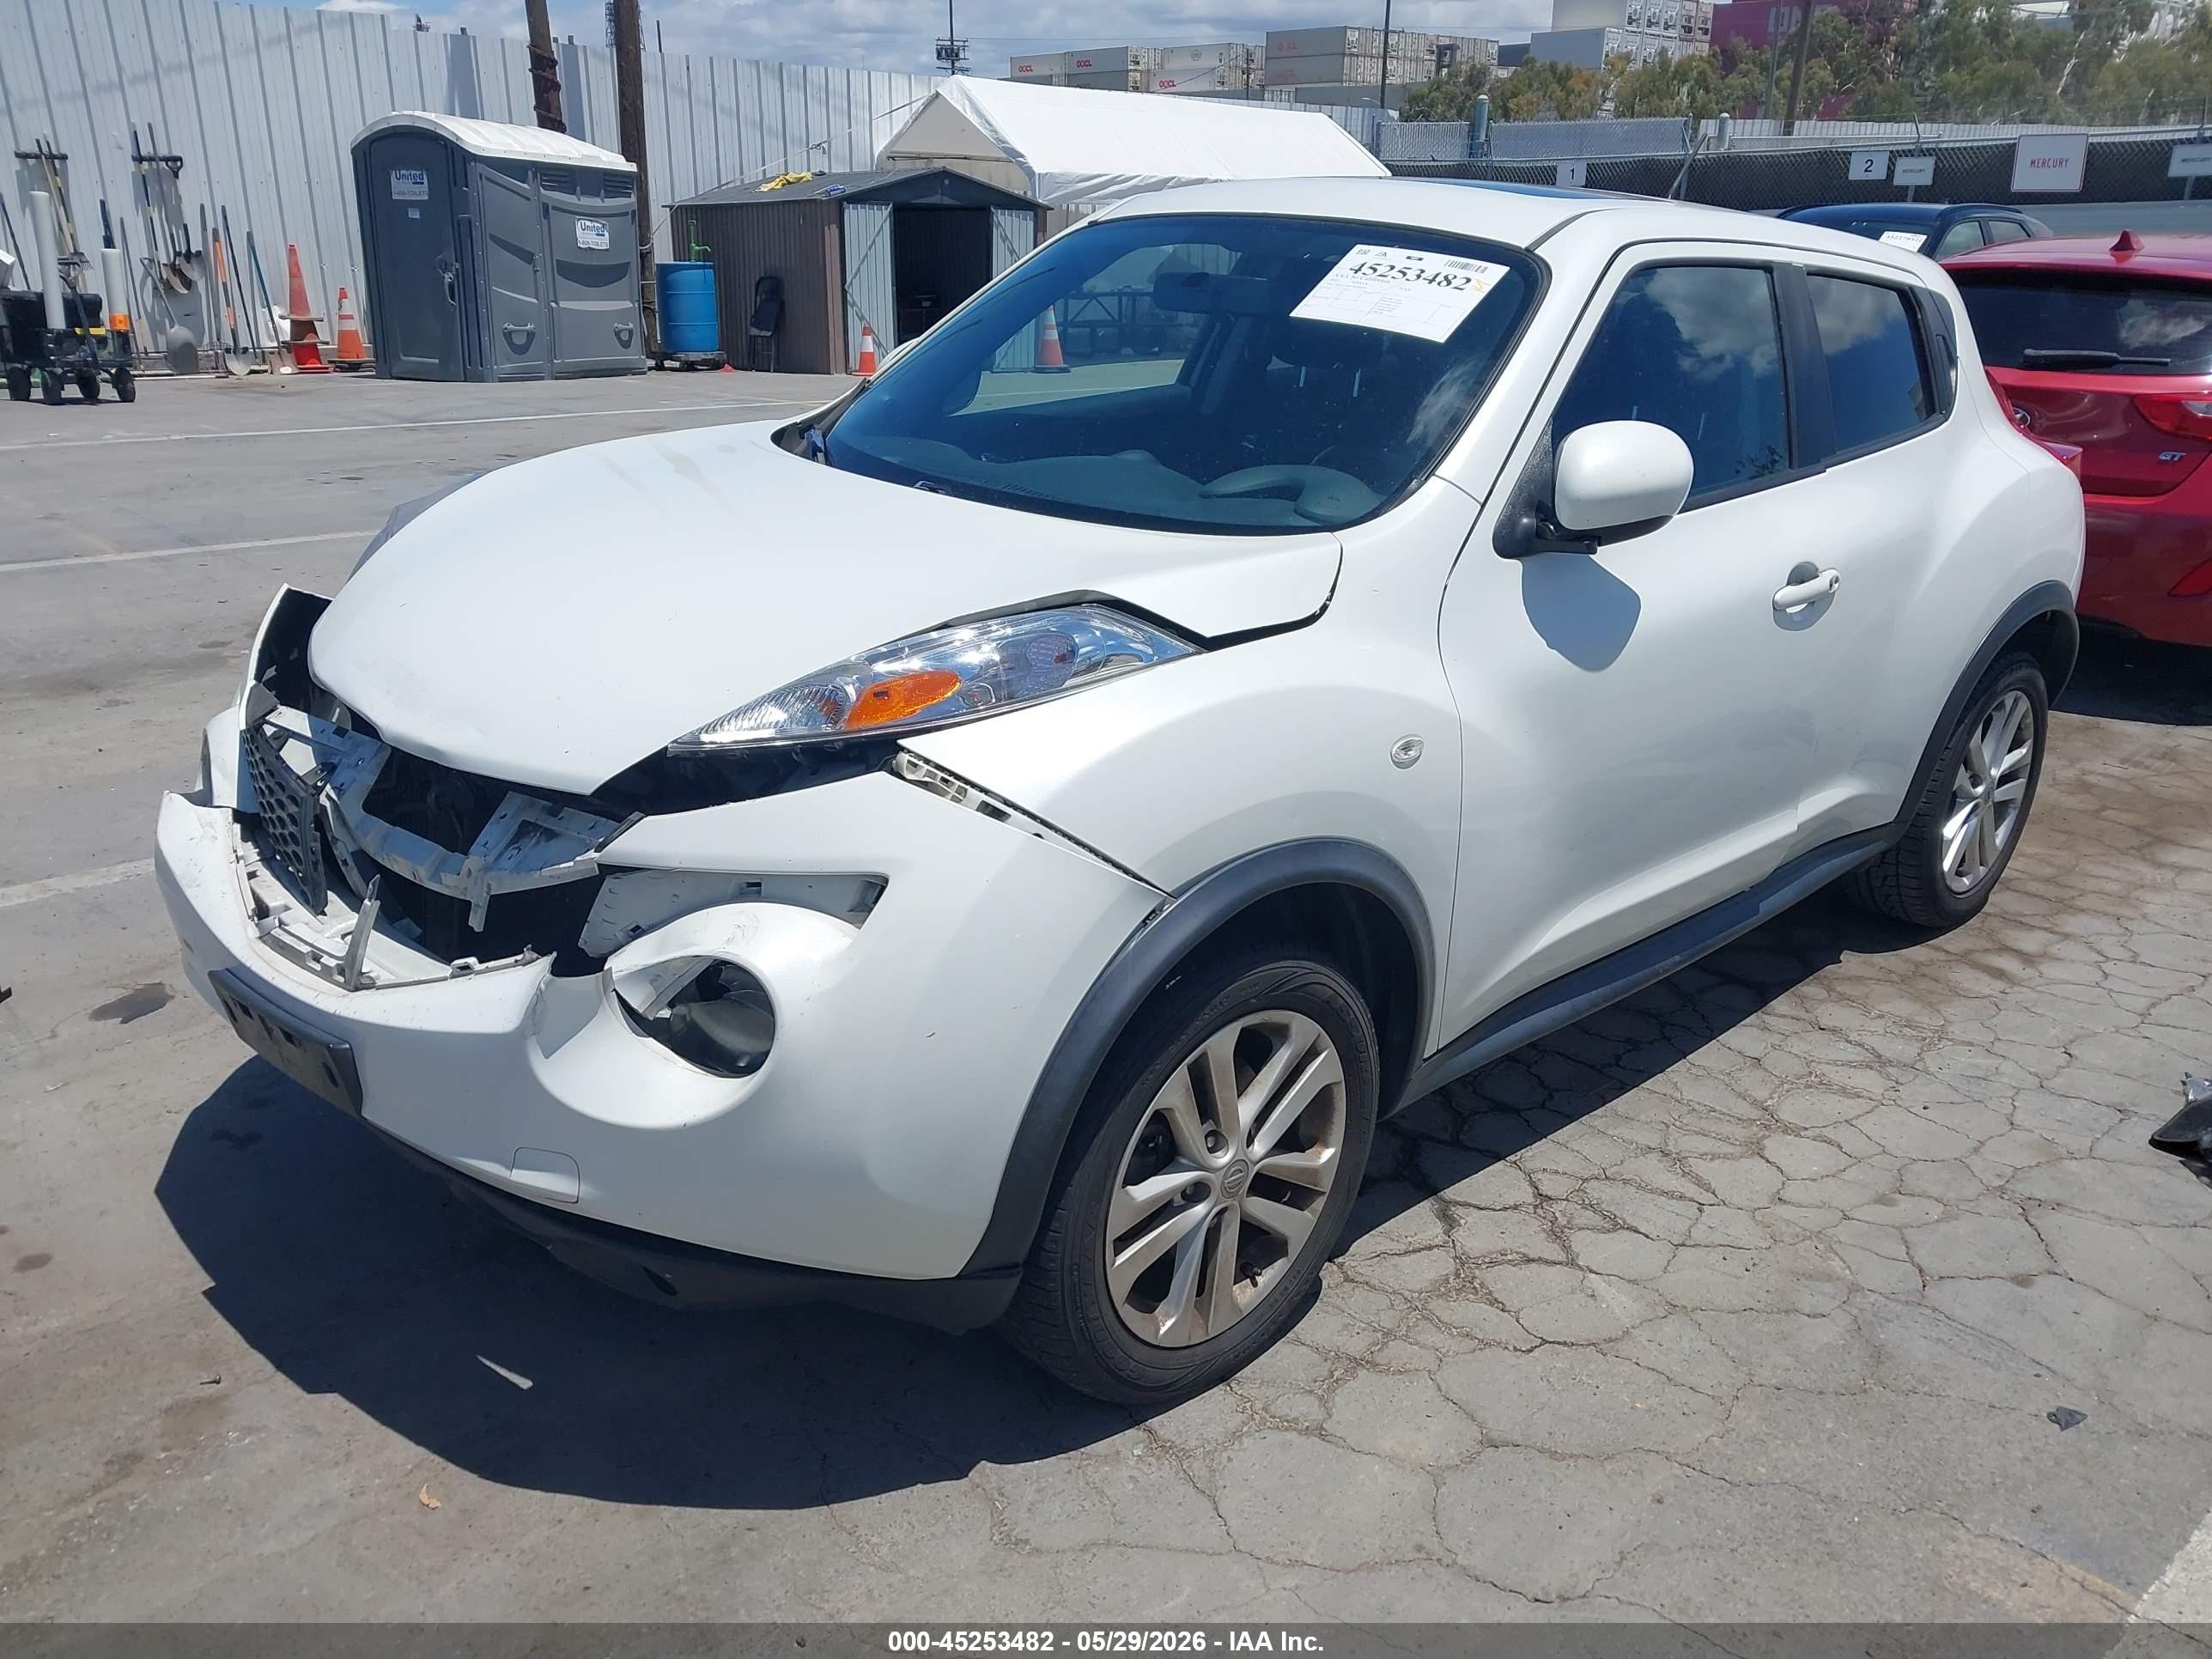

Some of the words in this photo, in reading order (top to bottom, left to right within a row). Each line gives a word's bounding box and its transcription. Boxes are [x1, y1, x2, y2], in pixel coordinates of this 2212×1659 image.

[1863, 158, 1875, 173] 2
[2030, 157, 2069, 168] MERCURY
[395, 170, 424, 181] United
[1570, 167, 1575, 180] 1
[580, 221, 605, 233] United
[1349, 261, 1473, 291] 45253482
[2159, 452, 2187, 461] GT
